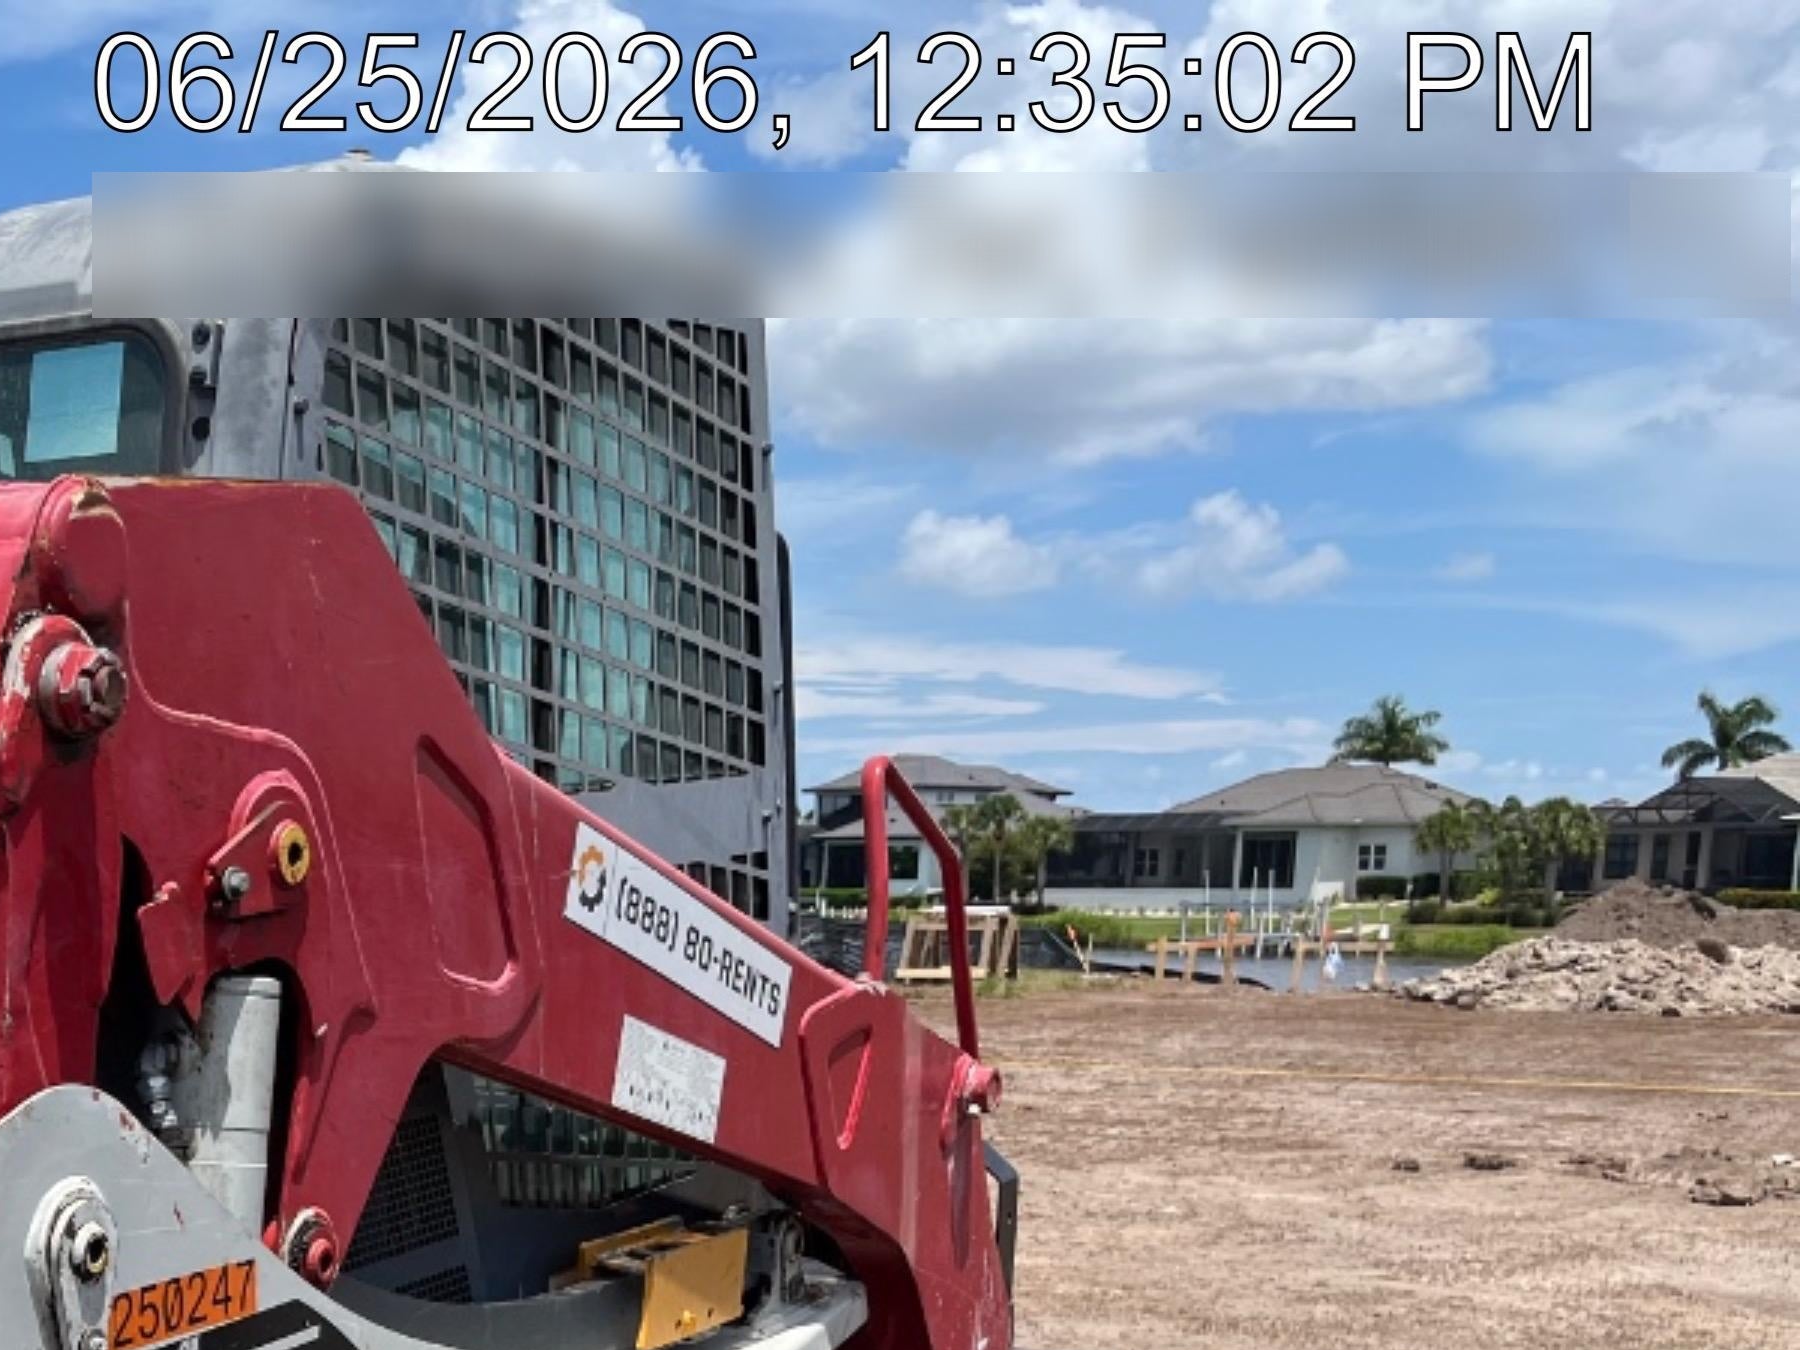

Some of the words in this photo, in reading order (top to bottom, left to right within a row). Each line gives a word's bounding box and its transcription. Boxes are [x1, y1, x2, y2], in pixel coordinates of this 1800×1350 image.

[616, 876, 679, 952] (888)
[683, 926, 782, 1017] 80-RENTS
[112, 1259, 257, 1348] 250247
